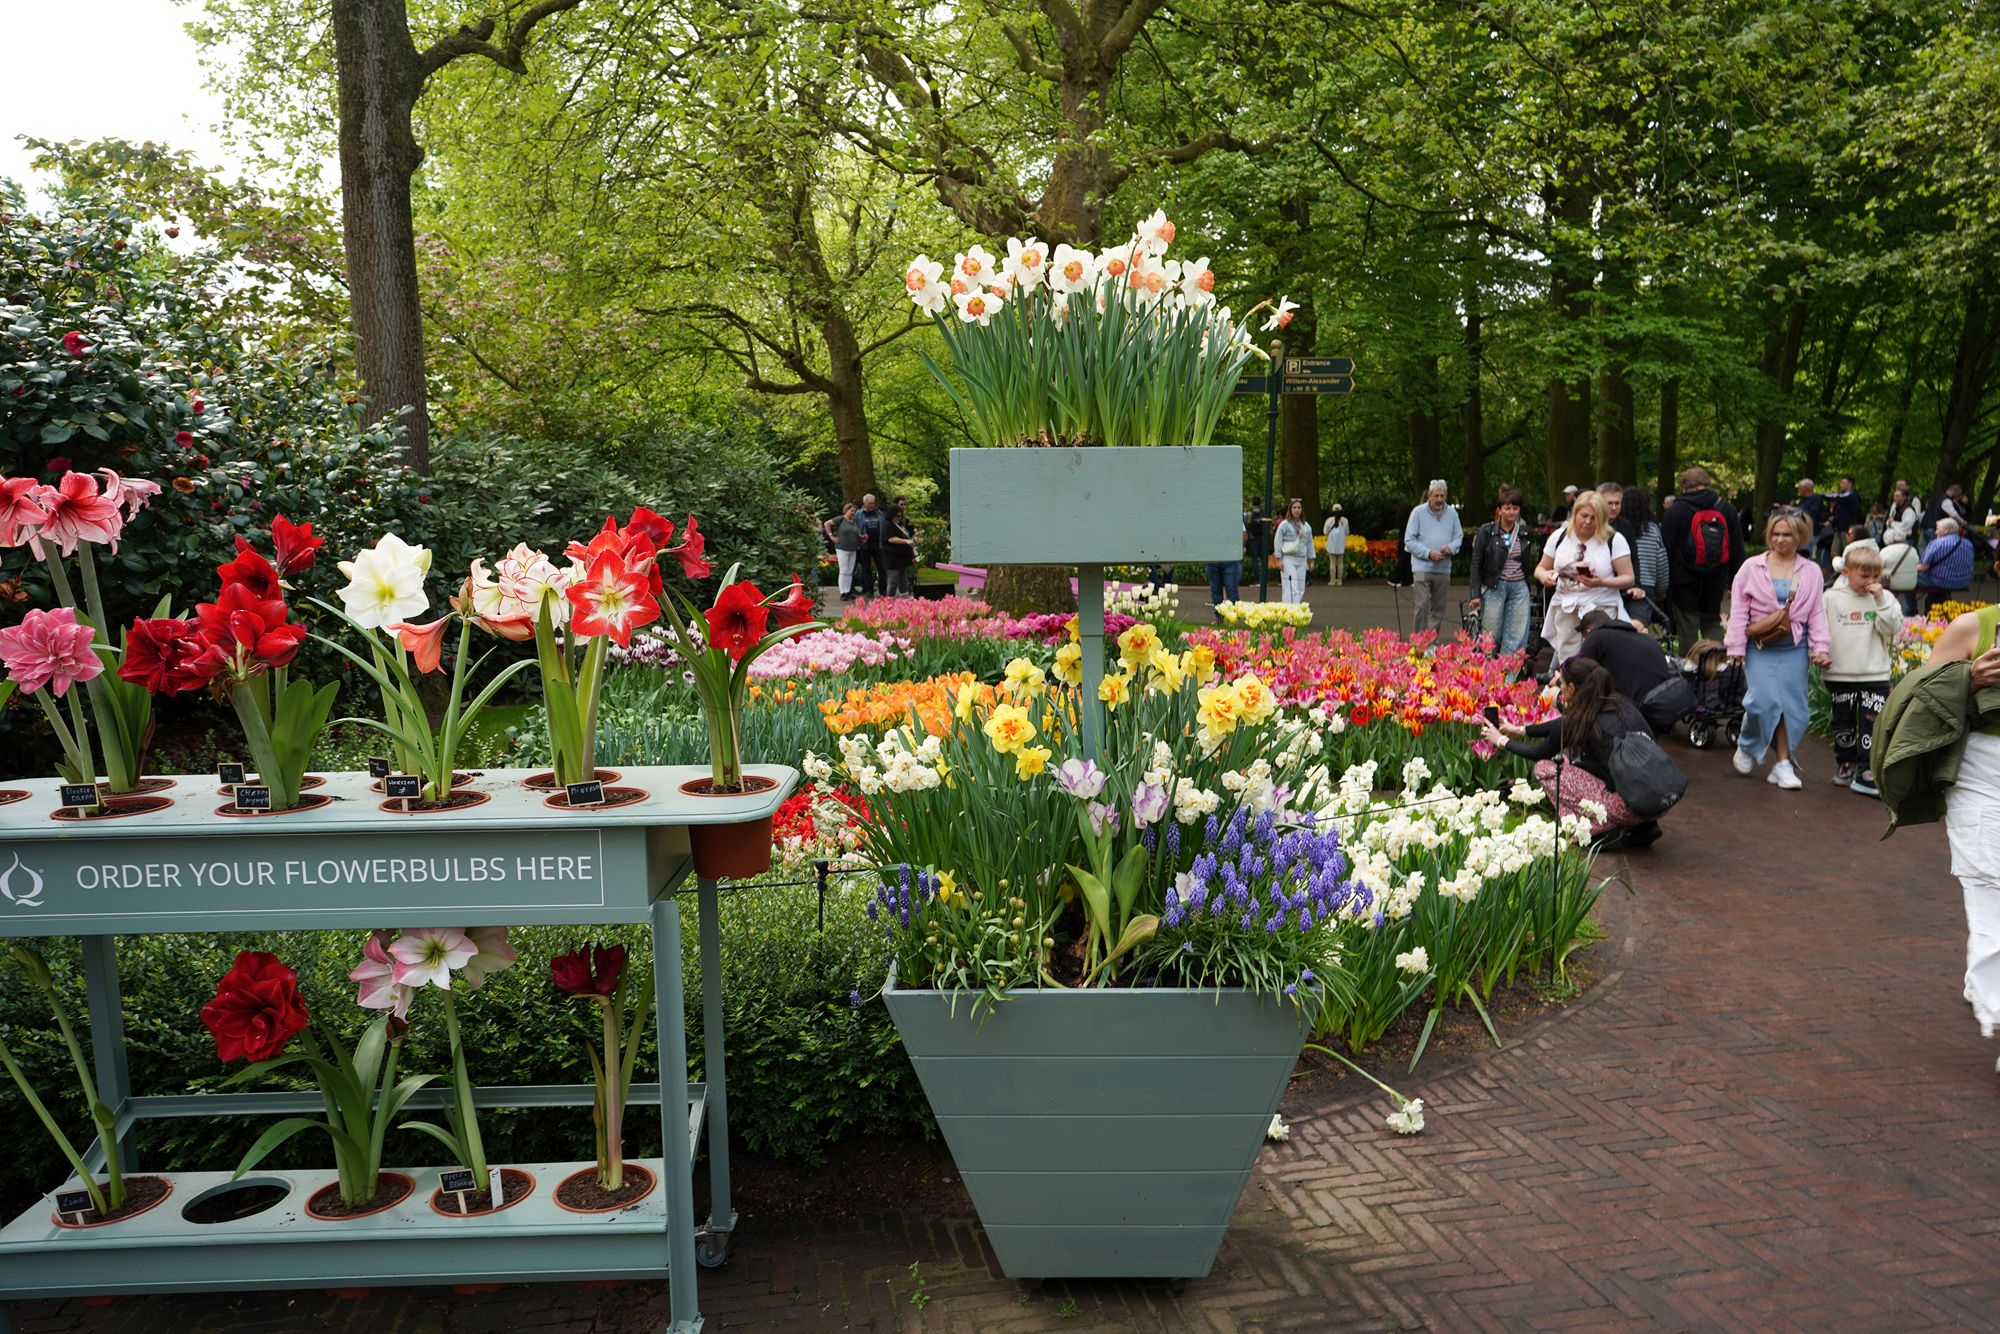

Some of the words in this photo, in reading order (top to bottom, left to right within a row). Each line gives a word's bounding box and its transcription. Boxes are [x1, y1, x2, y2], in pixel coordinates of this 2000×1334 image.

[76, 863, 182, 889] ORDER
[188, 861, 276, 886] YOUR
[284, 857, 506, 885] FLOWERBULBS
[516, 855, 593, 881] HERE
